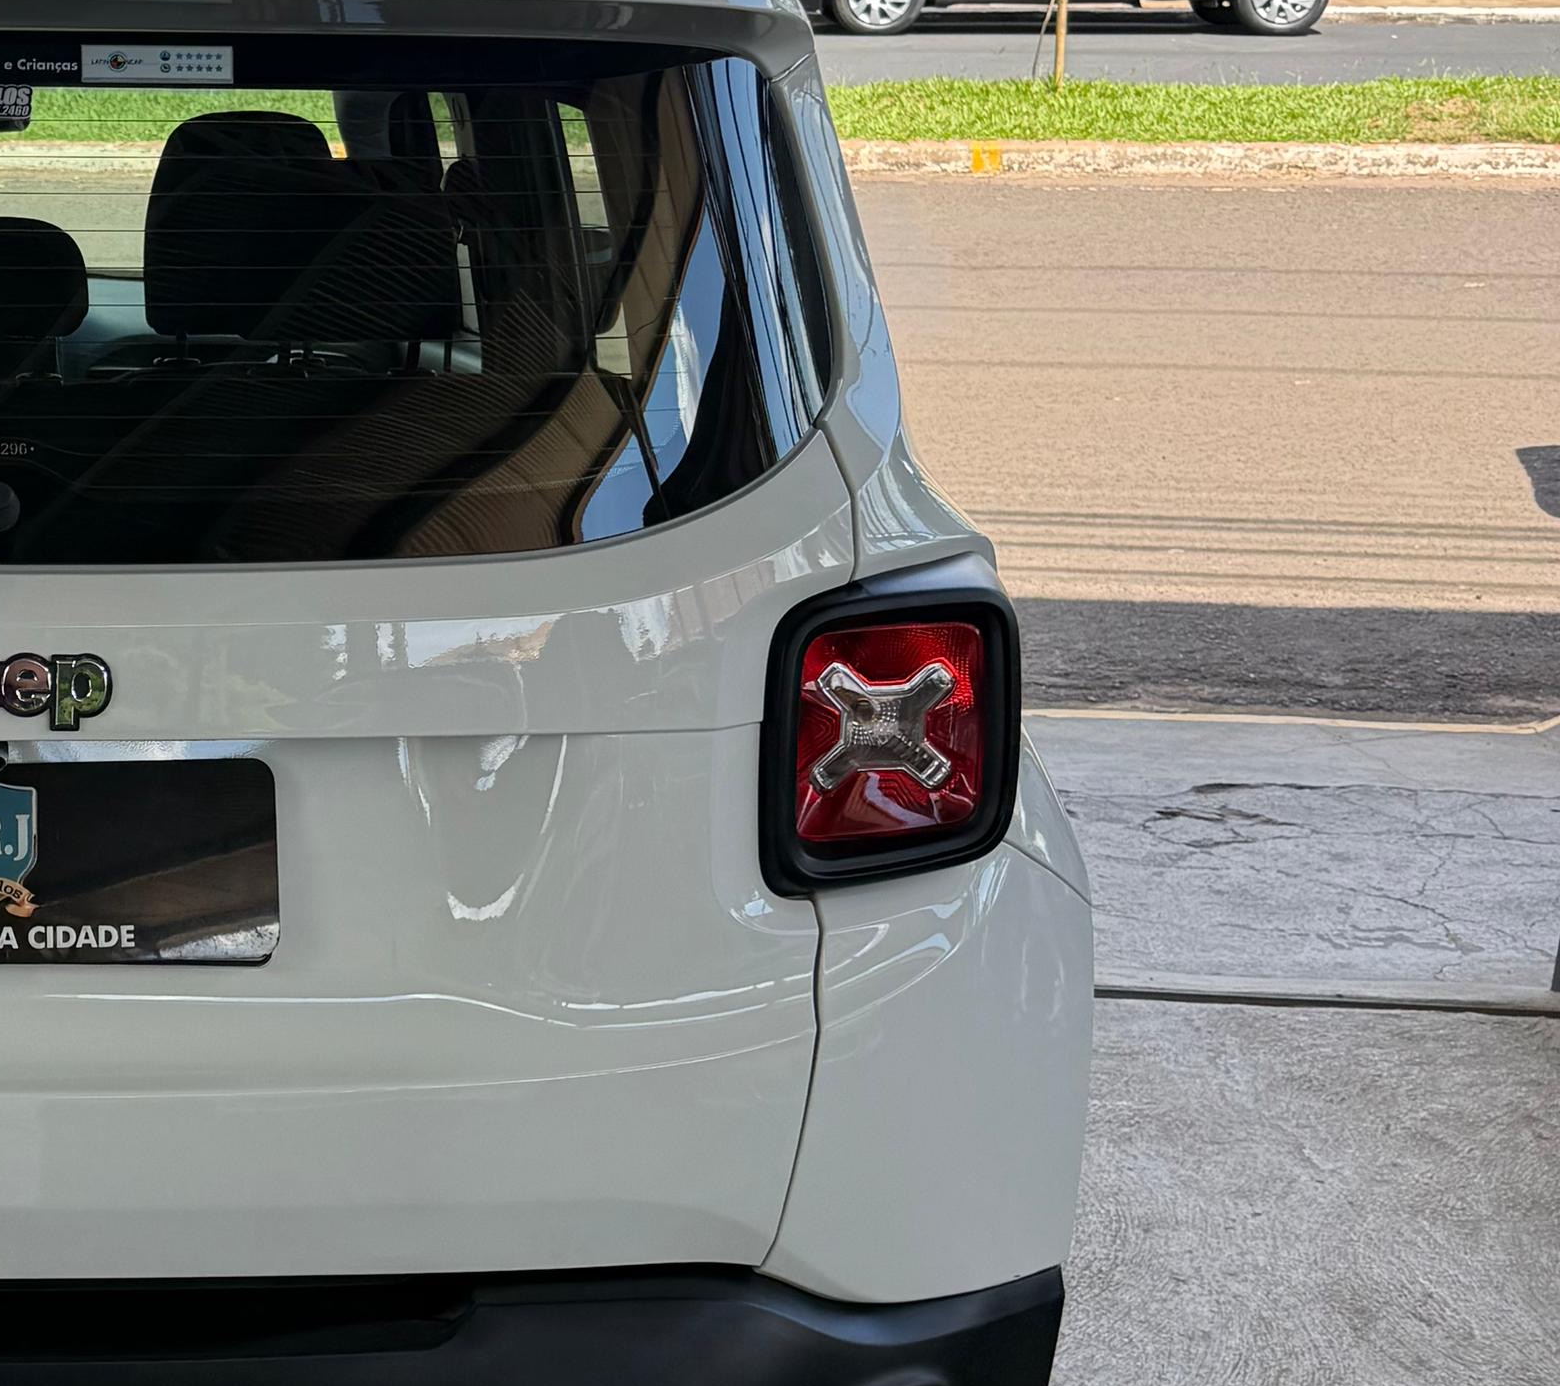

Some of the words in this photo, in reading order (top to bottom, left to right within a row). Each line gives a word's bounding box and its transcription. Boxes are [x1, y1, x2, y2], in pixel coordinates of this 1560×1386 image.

[4, 60, 13, 70] e
[17, 58, 78, 73] Crianças
[28, 924, 136, 950] CIDADE
